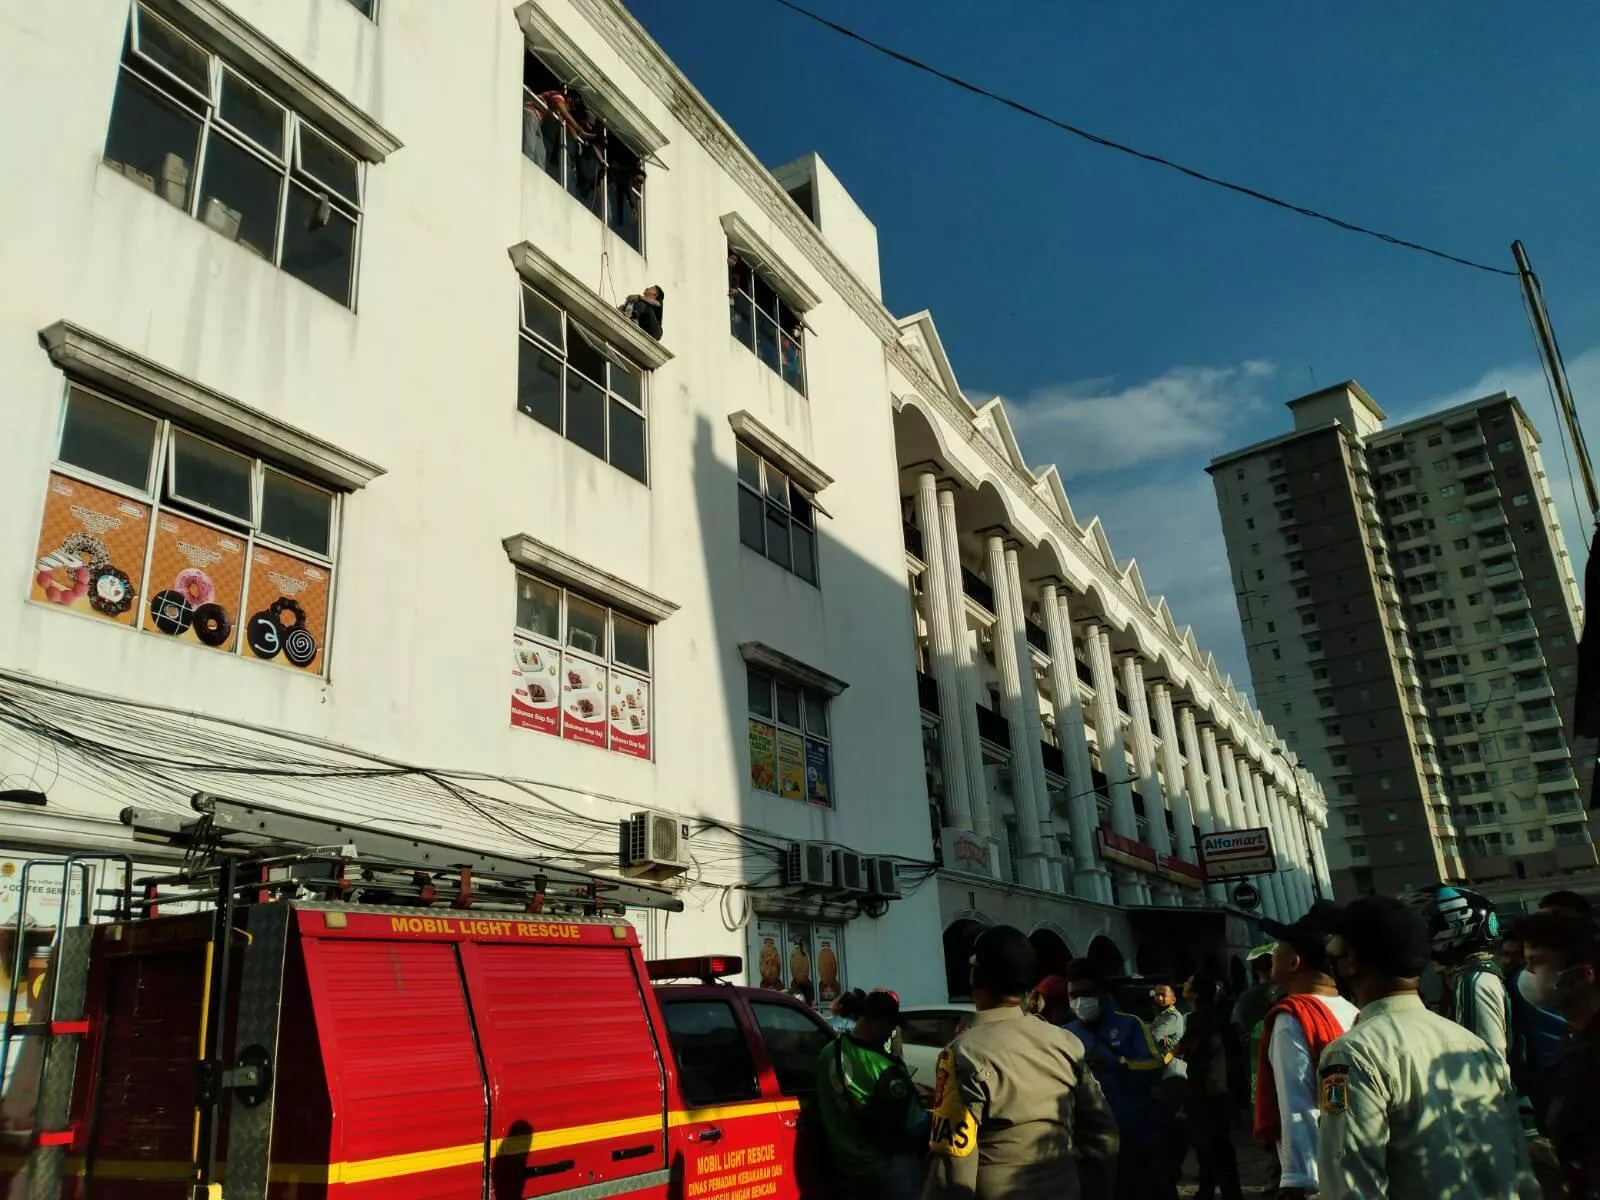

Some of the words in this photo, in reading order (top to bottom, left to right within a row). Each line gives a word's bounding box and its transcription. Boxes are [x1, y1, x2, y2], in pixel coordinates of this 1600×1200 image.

[1205, 834, 1264, 850] Alfamart
[9, 884, 44, 894] COFEE
[46, 886, 76, 896] SERS
[391, 917, 455, 934] MOBIL
[460, 920, 512, 937] LIGHT
[518, 923, 581, 938] RESCUE
[697, 1154, 722, 1175] MOBIL
[723, 1149, 747, 1169] LIGHT
[747, 1144, 775, 1165] RESCUE
[688, 1180, 708, 1196] DINAS
[708, 1173, 737, 1191] PEMADAM
[737, 1166, 770, 1186] KEBAKARAN
[771, 1163, 782, 1178] DAN
[751, 1182, 777, 1198] BENCANA
